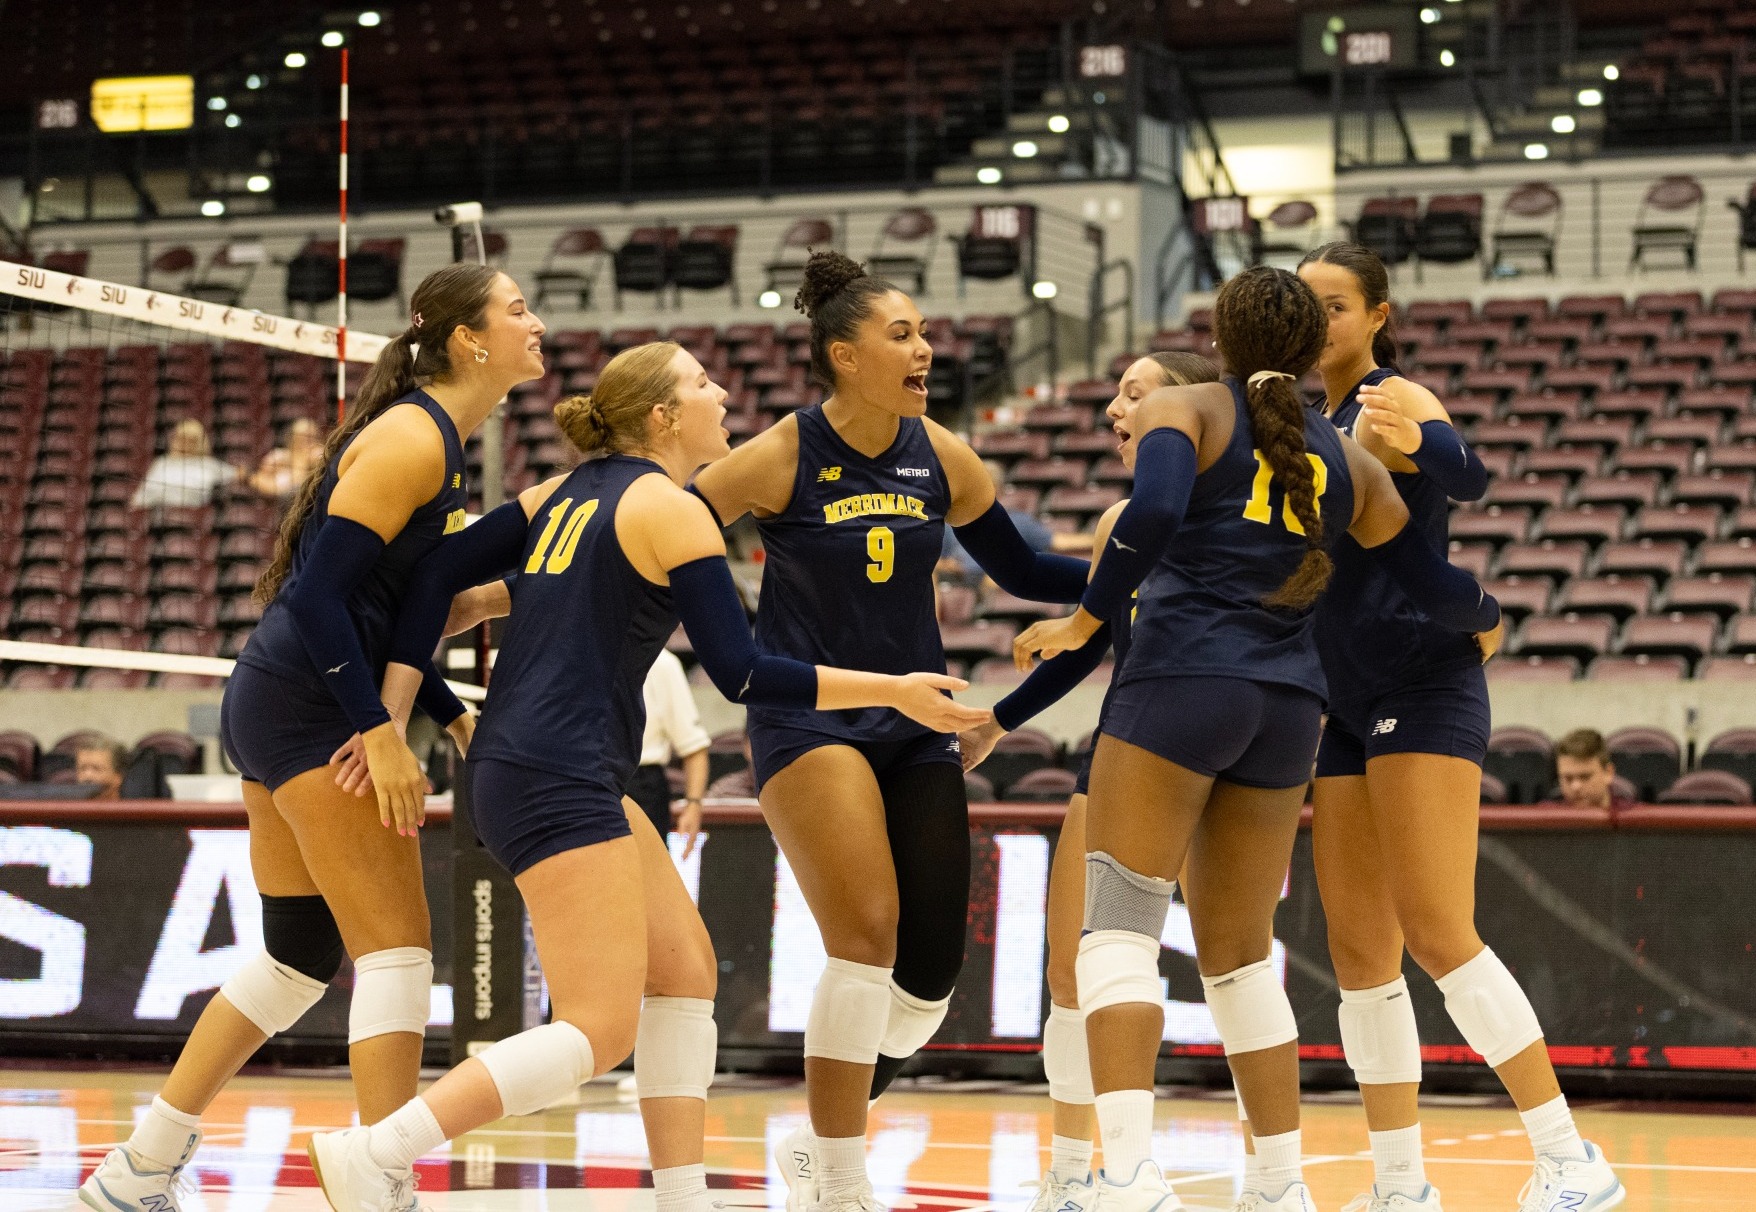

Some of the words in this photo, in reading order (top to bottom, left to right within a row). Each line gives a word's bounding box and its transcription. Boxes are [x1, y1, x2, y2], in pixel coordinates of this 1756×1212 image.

[17, 268, 46, 289] SIU
[100, 285, 127, 305] SIU
[179, 300, 204, 320] SIU
[252, 315, 278, 335] SIU
[321, 330, 338, 345] SI
[896, 467, 930, 477] METRO
[524, 497, 599, 575] 10
[823, 493, 929, 524] MERRIMACK
[866, 526, 895, 583] 9
[472, 879, 494, 942] sports
[472, 942, 494, 1020] imports
